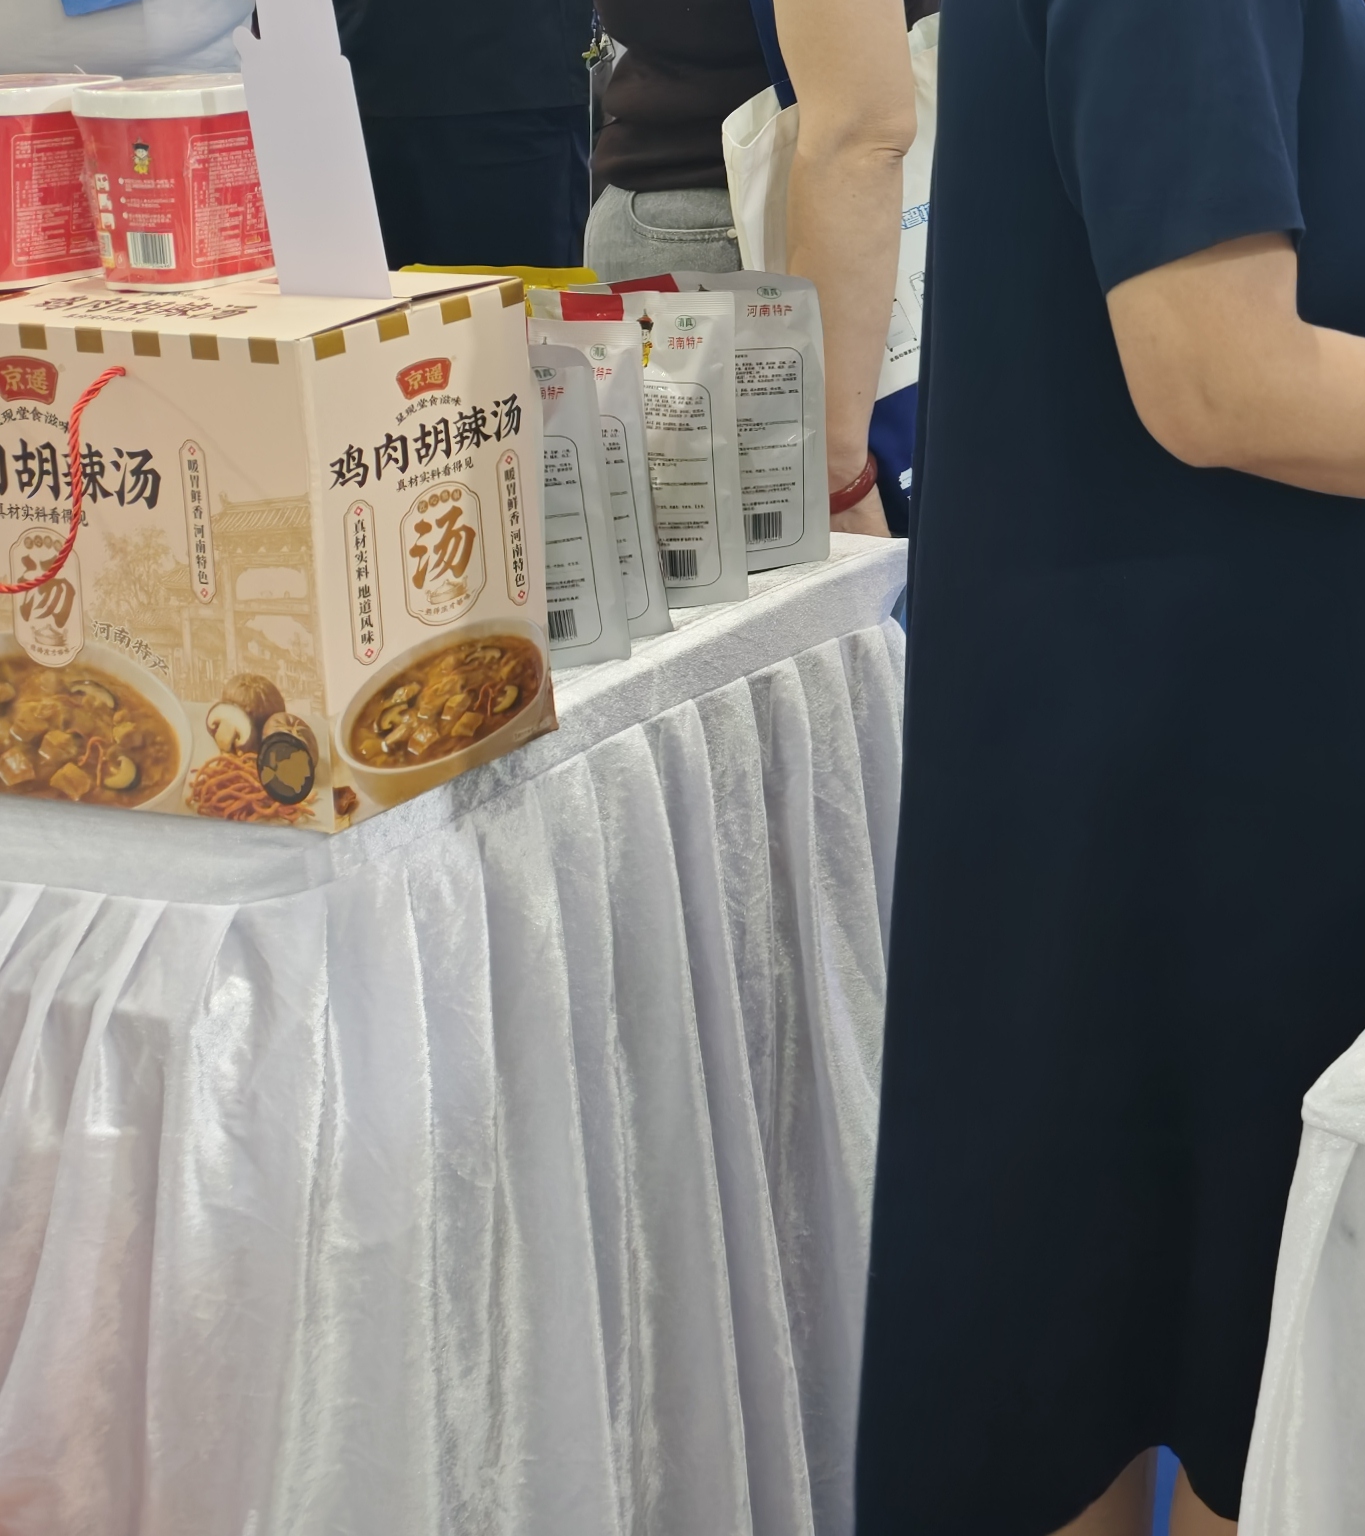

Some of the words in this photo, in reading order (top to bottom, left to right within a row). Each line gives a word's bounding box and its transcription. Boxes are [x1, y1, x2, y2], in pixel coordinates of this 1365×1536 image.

[746, 304, 794, 318] 河南特产
[667, 336, 703, 351] 河南特产
[1, 365, 50, 395] 京遥
[404, 363, 445, 392] 京遥
[592, 367, 613, 382] 特产
[0, 405, 70, 434] 现堂食滋味
[329, 393, 522, 491] 鸡肉胡辣汤
[0, 437, 162, 510] 胡辣汤
[504, 466, 520, 528] 暖胃鲜香
[192, 524, 209, 586] 河南特色
[352, 517, 371, 582] 真材实料
[409, 505, 477, 590] 汤
[510, 528, 526, 588] 河南特色
[17, 551, 76, 629] 汤
[357, 584, 377, 647] 地道风味
[91, 619, 170, 676] 河南特产
